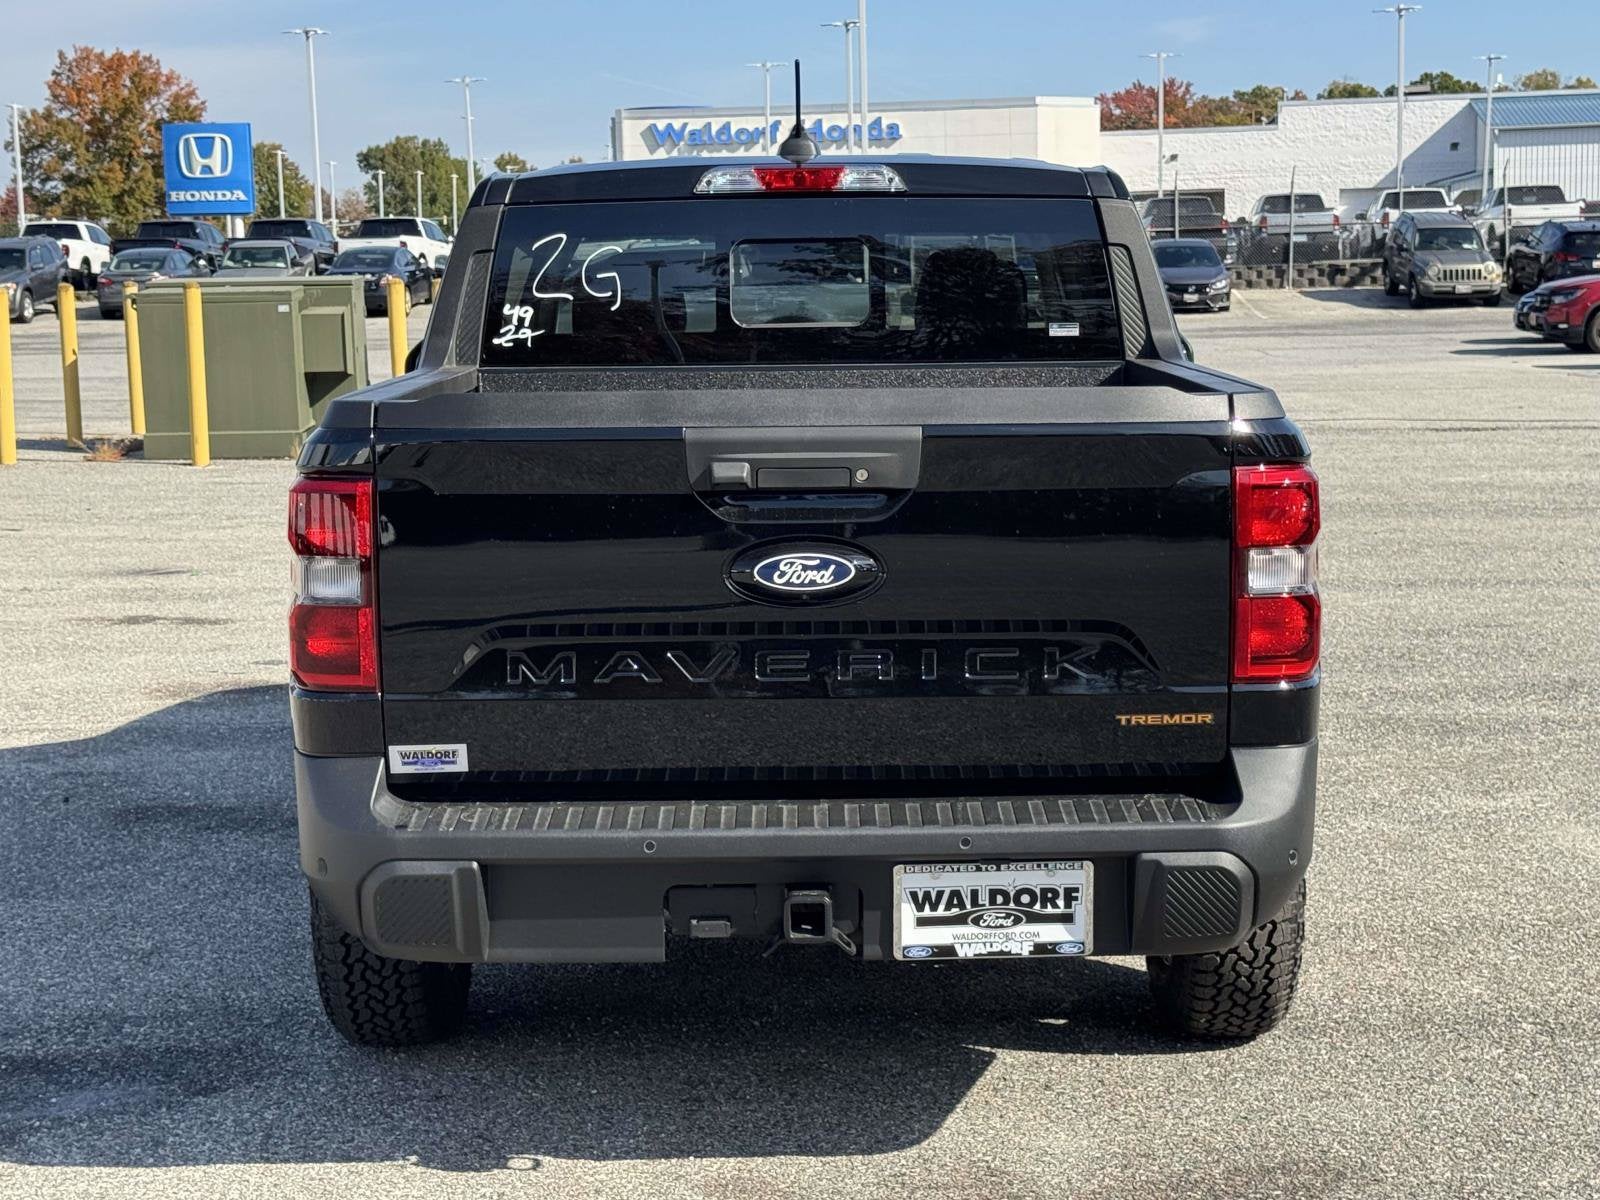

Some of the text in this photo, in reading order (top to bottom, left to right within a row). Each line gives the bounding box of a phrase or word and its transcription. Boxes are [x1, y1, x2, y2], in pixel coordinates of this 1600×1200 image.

[650, 120, 781, 146] Waldorf
[169, 189, 248, 202] HONDA
[773, 558, 836, 584] Ford
[506, 648, 1101, 684] MAVERICK
[1115, 712, 1215, 726] TREMOR
[399, 750, 458, 761] WALDORF
[906, 861, 1083, 873] DEDICATED TO EXCELLENCE
[908, 886, 1080, 912] WALDORF
[979, 912, 1015, 927] Ford
[952, 931, 1040, 941] WALDORFFORD.COM
[953, 940, 1034, 957] WALDORF
